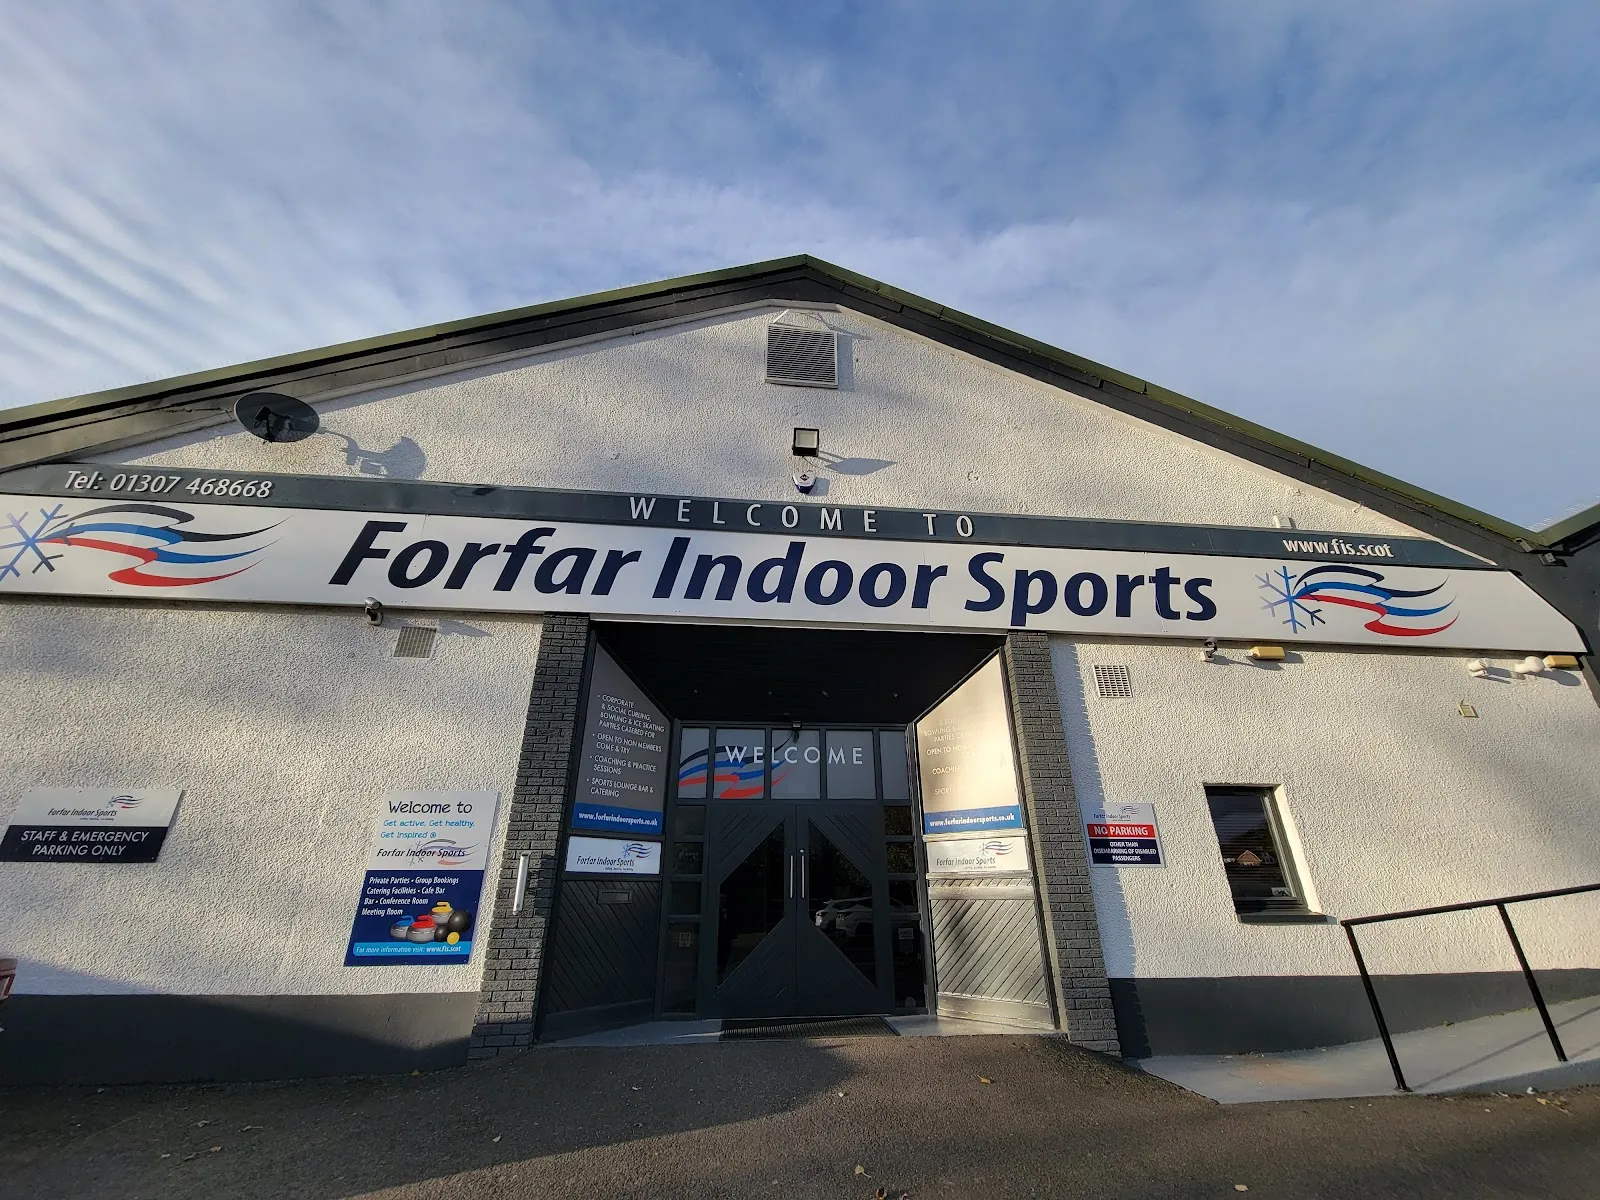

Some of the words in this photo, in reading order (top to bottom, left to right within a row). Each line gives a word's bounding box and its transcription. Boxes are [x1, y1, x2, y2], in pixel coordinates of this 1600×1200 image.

[64, 470, 104, 491] Tel:
[109, 473, 181, 495] 01307
[186, 478, 273, 499] 468668
[629, 496, 877, 533] WELCOME
[923, 513, 974, 538] TO
[1283, 538, 1395, 558] www.fis.scot
[328, 519, 642, 596] Forfar
[652, 536, 948, 609] Indoor
[964, 551, 1217, 627] Sports
[602, 694, 634, 708] CORPORATE
[607, 704, 626, 715] SOCIAL
[600, 712, 627, 724] BOWLING
[643, 721, 665, 732] SKATING
[599, 720, 620, 731] PARTIES
[622, 725, 643, 736] CATERED
[645, 730, 655, 738] FOR
[596, 742, 614, 751] COME
[597, 733, 614, 741] OPEN
[624, 738, 637, 746] NON
[638, 742, 662, 752] MEMBERS
[725, 746, 864, 765] WELCOME
[926, 747, 942, 756] OPEN
[595, 755, 626, 766] COACHING
[633, 762, 656, 772] PRACTICE
[593, 764, 621, 775] SESSIONS
[592, 778, 612, 787] SPORTS
[614, 780, 637, 791] LOUNGE
[590, 787, 620, 798] CATERING
[389, 800, 451, 814] Welcome
[457, 801, 472, 814] to
[96, 809, 118, 817] Sports
[445, 820, 475, 828] healthy.
[579, 812, 658, 826] www.forfarindoorsports.co.uk
[930, 813, 1014, 827] www.forfarindoorsports.co.uk
[21, 830, 57, 842] STAFF
[59, 831, 68, 841] &
[71, 831, 149, 842] EMERGENCY
[1094, 826, 1108, 834] NO
[1110, 826, 1148, 835] PARKING
[32, 845, 89, 856] PARKING
[91, 845, 126, 856] ONLY
[376, 849, 405, 857] Forfar
[406, 849, 437, 857] Indoor
[437, 849, 466, 858] Sports
[576, 856, 596, 865] Forfar
[597, 857, 616, 866] Indoor
[616, 858, 635, 867] Sports
[936, 857, 954, 866] Forfar
[976, 857, 996, 867] Sports
[415, 877, 432, 885] Group
[367, 887, 390, 895] Catering
[361, 908, 386, 917] Meeting
